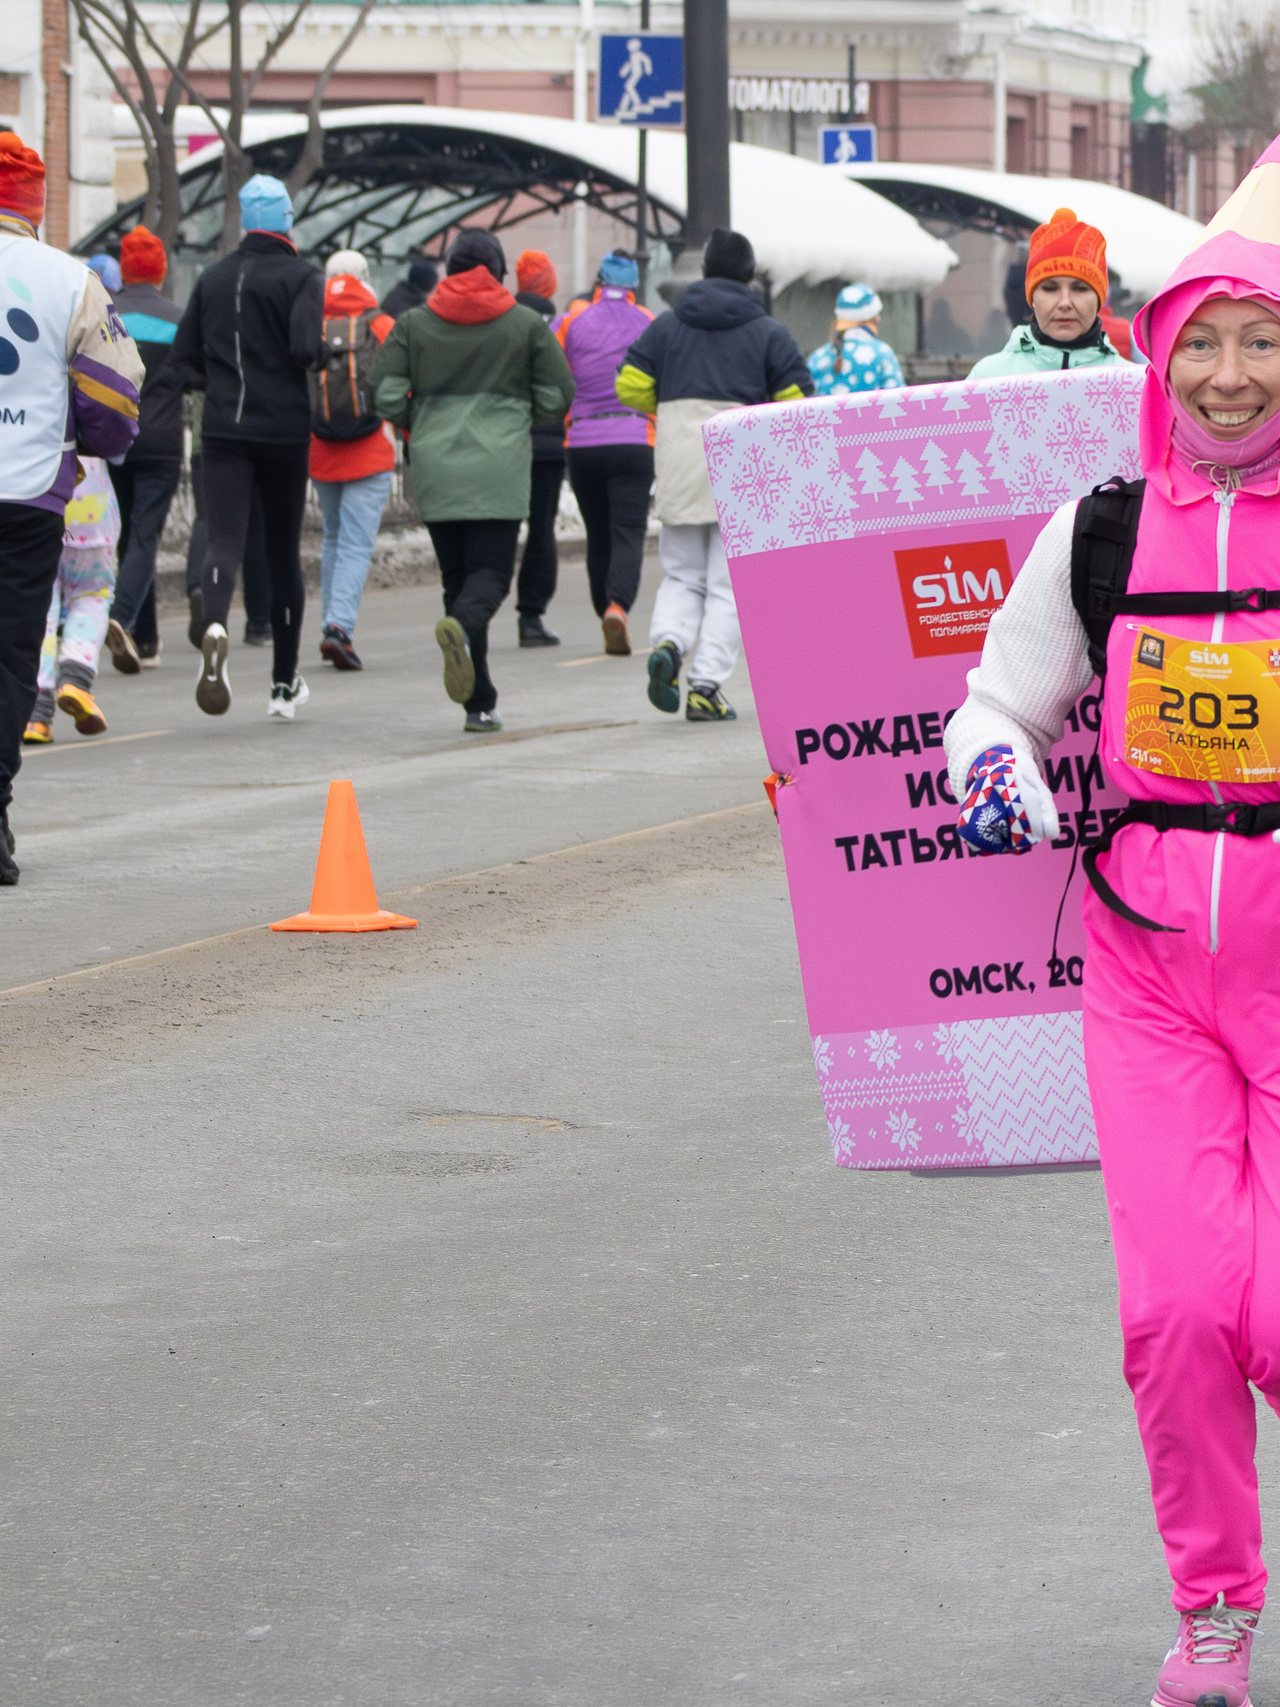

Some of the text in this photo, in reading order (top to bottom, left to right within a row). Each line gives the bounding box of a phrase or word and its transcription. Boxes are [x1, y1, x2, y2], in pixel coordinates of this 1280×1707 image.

[728, 78, 870, 114] ТОМАТОЛОГЯ
[918, 603, 1004, 625] РОЖДЕСТВЕНСК
[929, 621, 990, 638] ПОЛУМАРАФ
[1159, 685, 1259, 730] 203
[1166, 730, 1250, 751] ТАТЬЯНА
[835, 823, 981, 872] ТАТЬЯ
[929, 955, 1084, 998] ОМСК, 20
